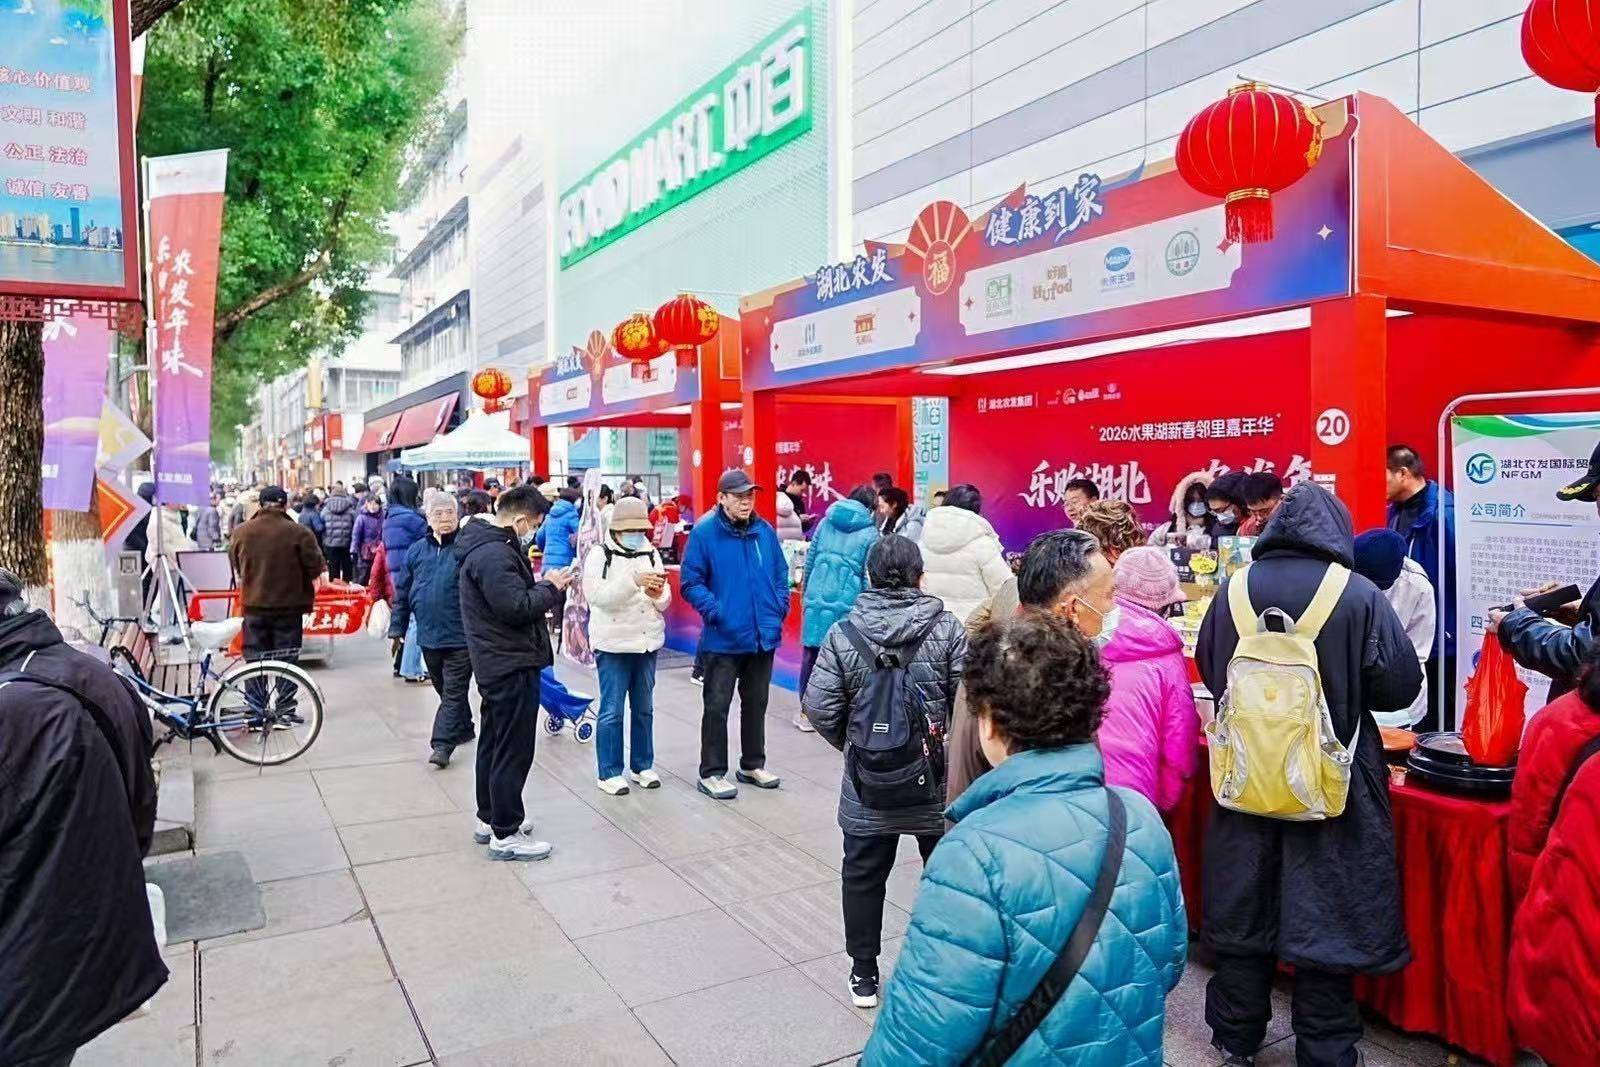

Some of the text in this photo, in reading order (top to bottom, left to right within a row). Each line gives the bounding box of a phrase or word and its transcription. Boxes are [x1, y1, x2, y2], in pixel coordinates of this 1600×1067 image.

[723, 25, 806, 152] 中百
[1, 105, 86, 131] 文明 和谐
[4, 142, 88, 166] 公正 法治
[6, 179, 89, 201] 诚信 友善
[985, 174, 1104, 248] 健康到家
[816, 248, 894, 300] 湖北农发
[928, 254, 950, 287] 福
[162, 248, 203, 378] 农发年味
[1099, 416, 1274, 442] 2026水果湖新春邻里嘉年华
[1319, 416, 1346, 436] 20
[1501, 471, 1541, 479] NFGM
[1471, 503, 1526, 518] 公司简介
